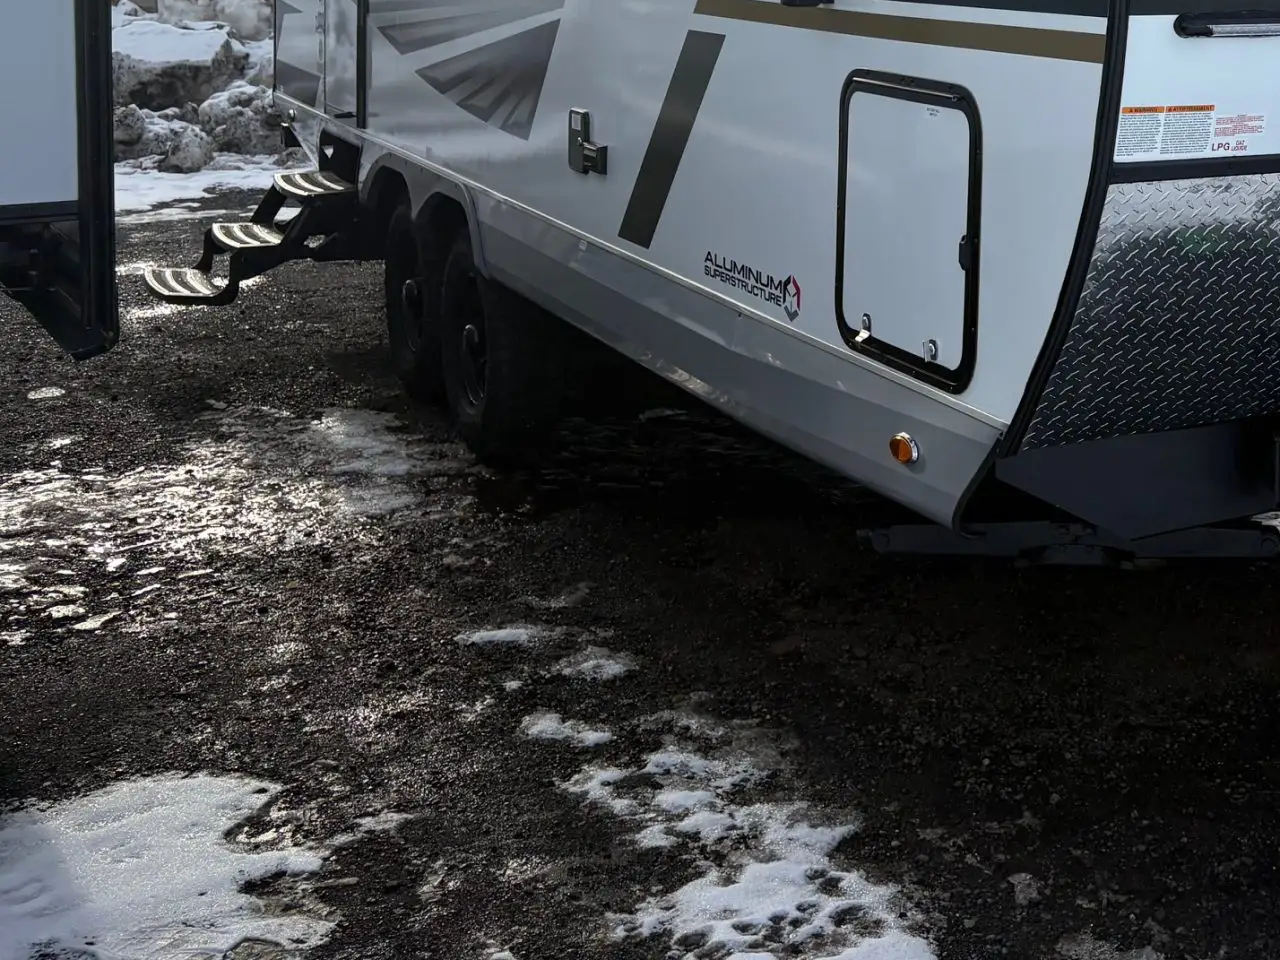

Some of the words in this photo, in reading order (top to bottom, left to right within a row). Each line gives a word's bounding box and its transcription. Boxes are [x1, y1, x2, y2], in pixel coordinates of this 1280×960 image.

[1211, 142, 1230, 152] LPG
[704, 251, 783, 294] ALUMINUM
[704, 265, 782, 307] SUPERSTRUCTURE
